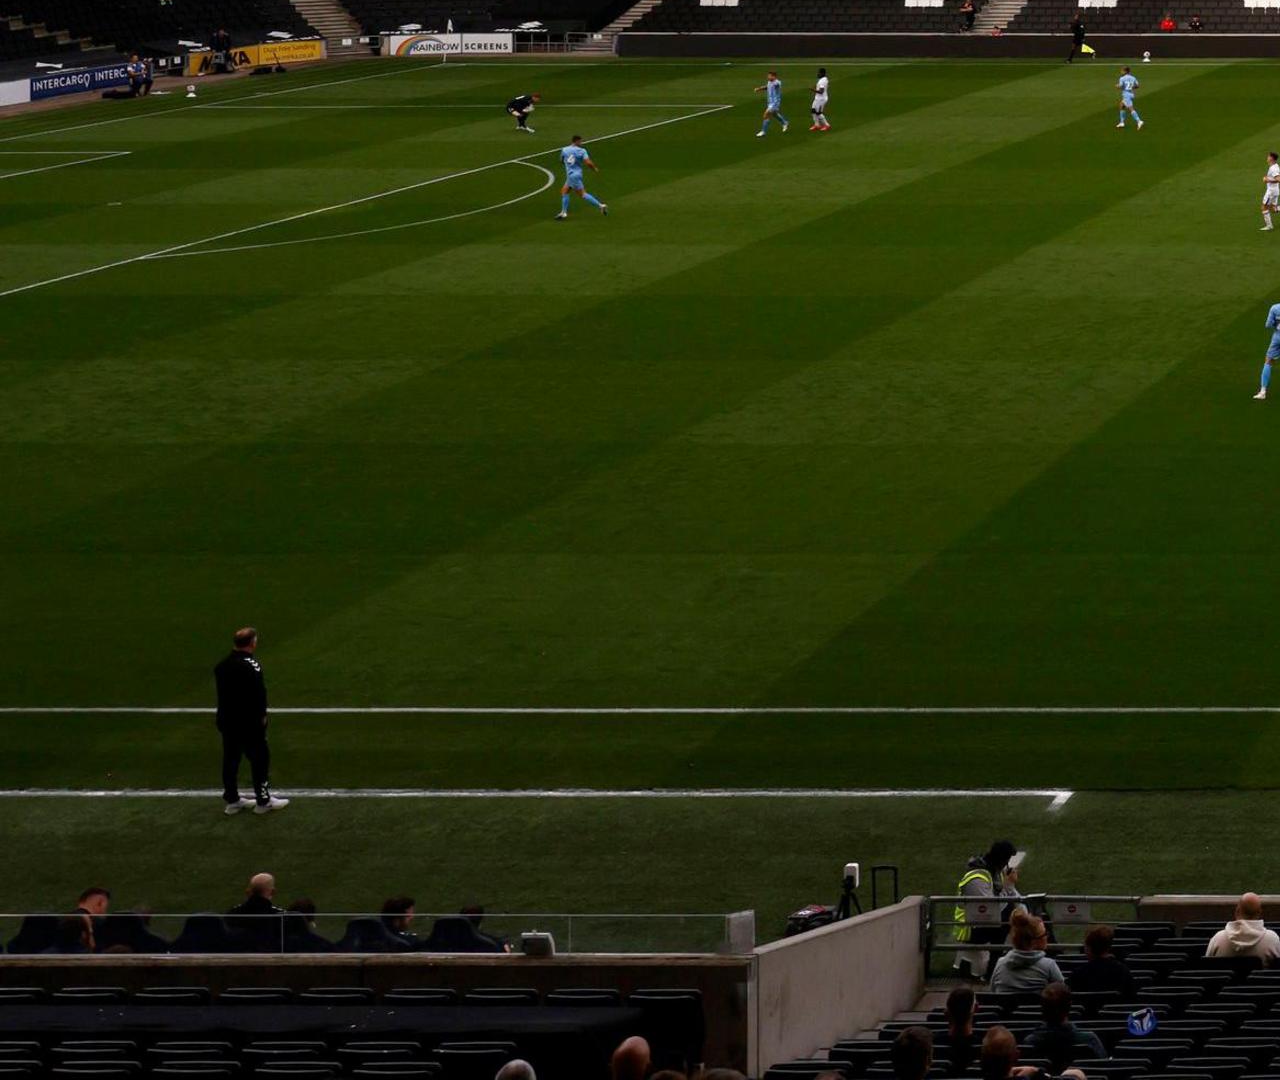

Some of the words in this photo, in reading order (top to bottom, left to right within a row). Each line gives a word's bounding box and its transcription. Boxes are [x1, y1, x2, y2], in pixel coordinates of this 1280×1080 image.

[413, 43, 460, 51] RAINBOW
[464, 42, 509, 50] SCREENS
[32, 73, 90, 91] INTERCARGO
[95, 68, 128, 81] INTERC
